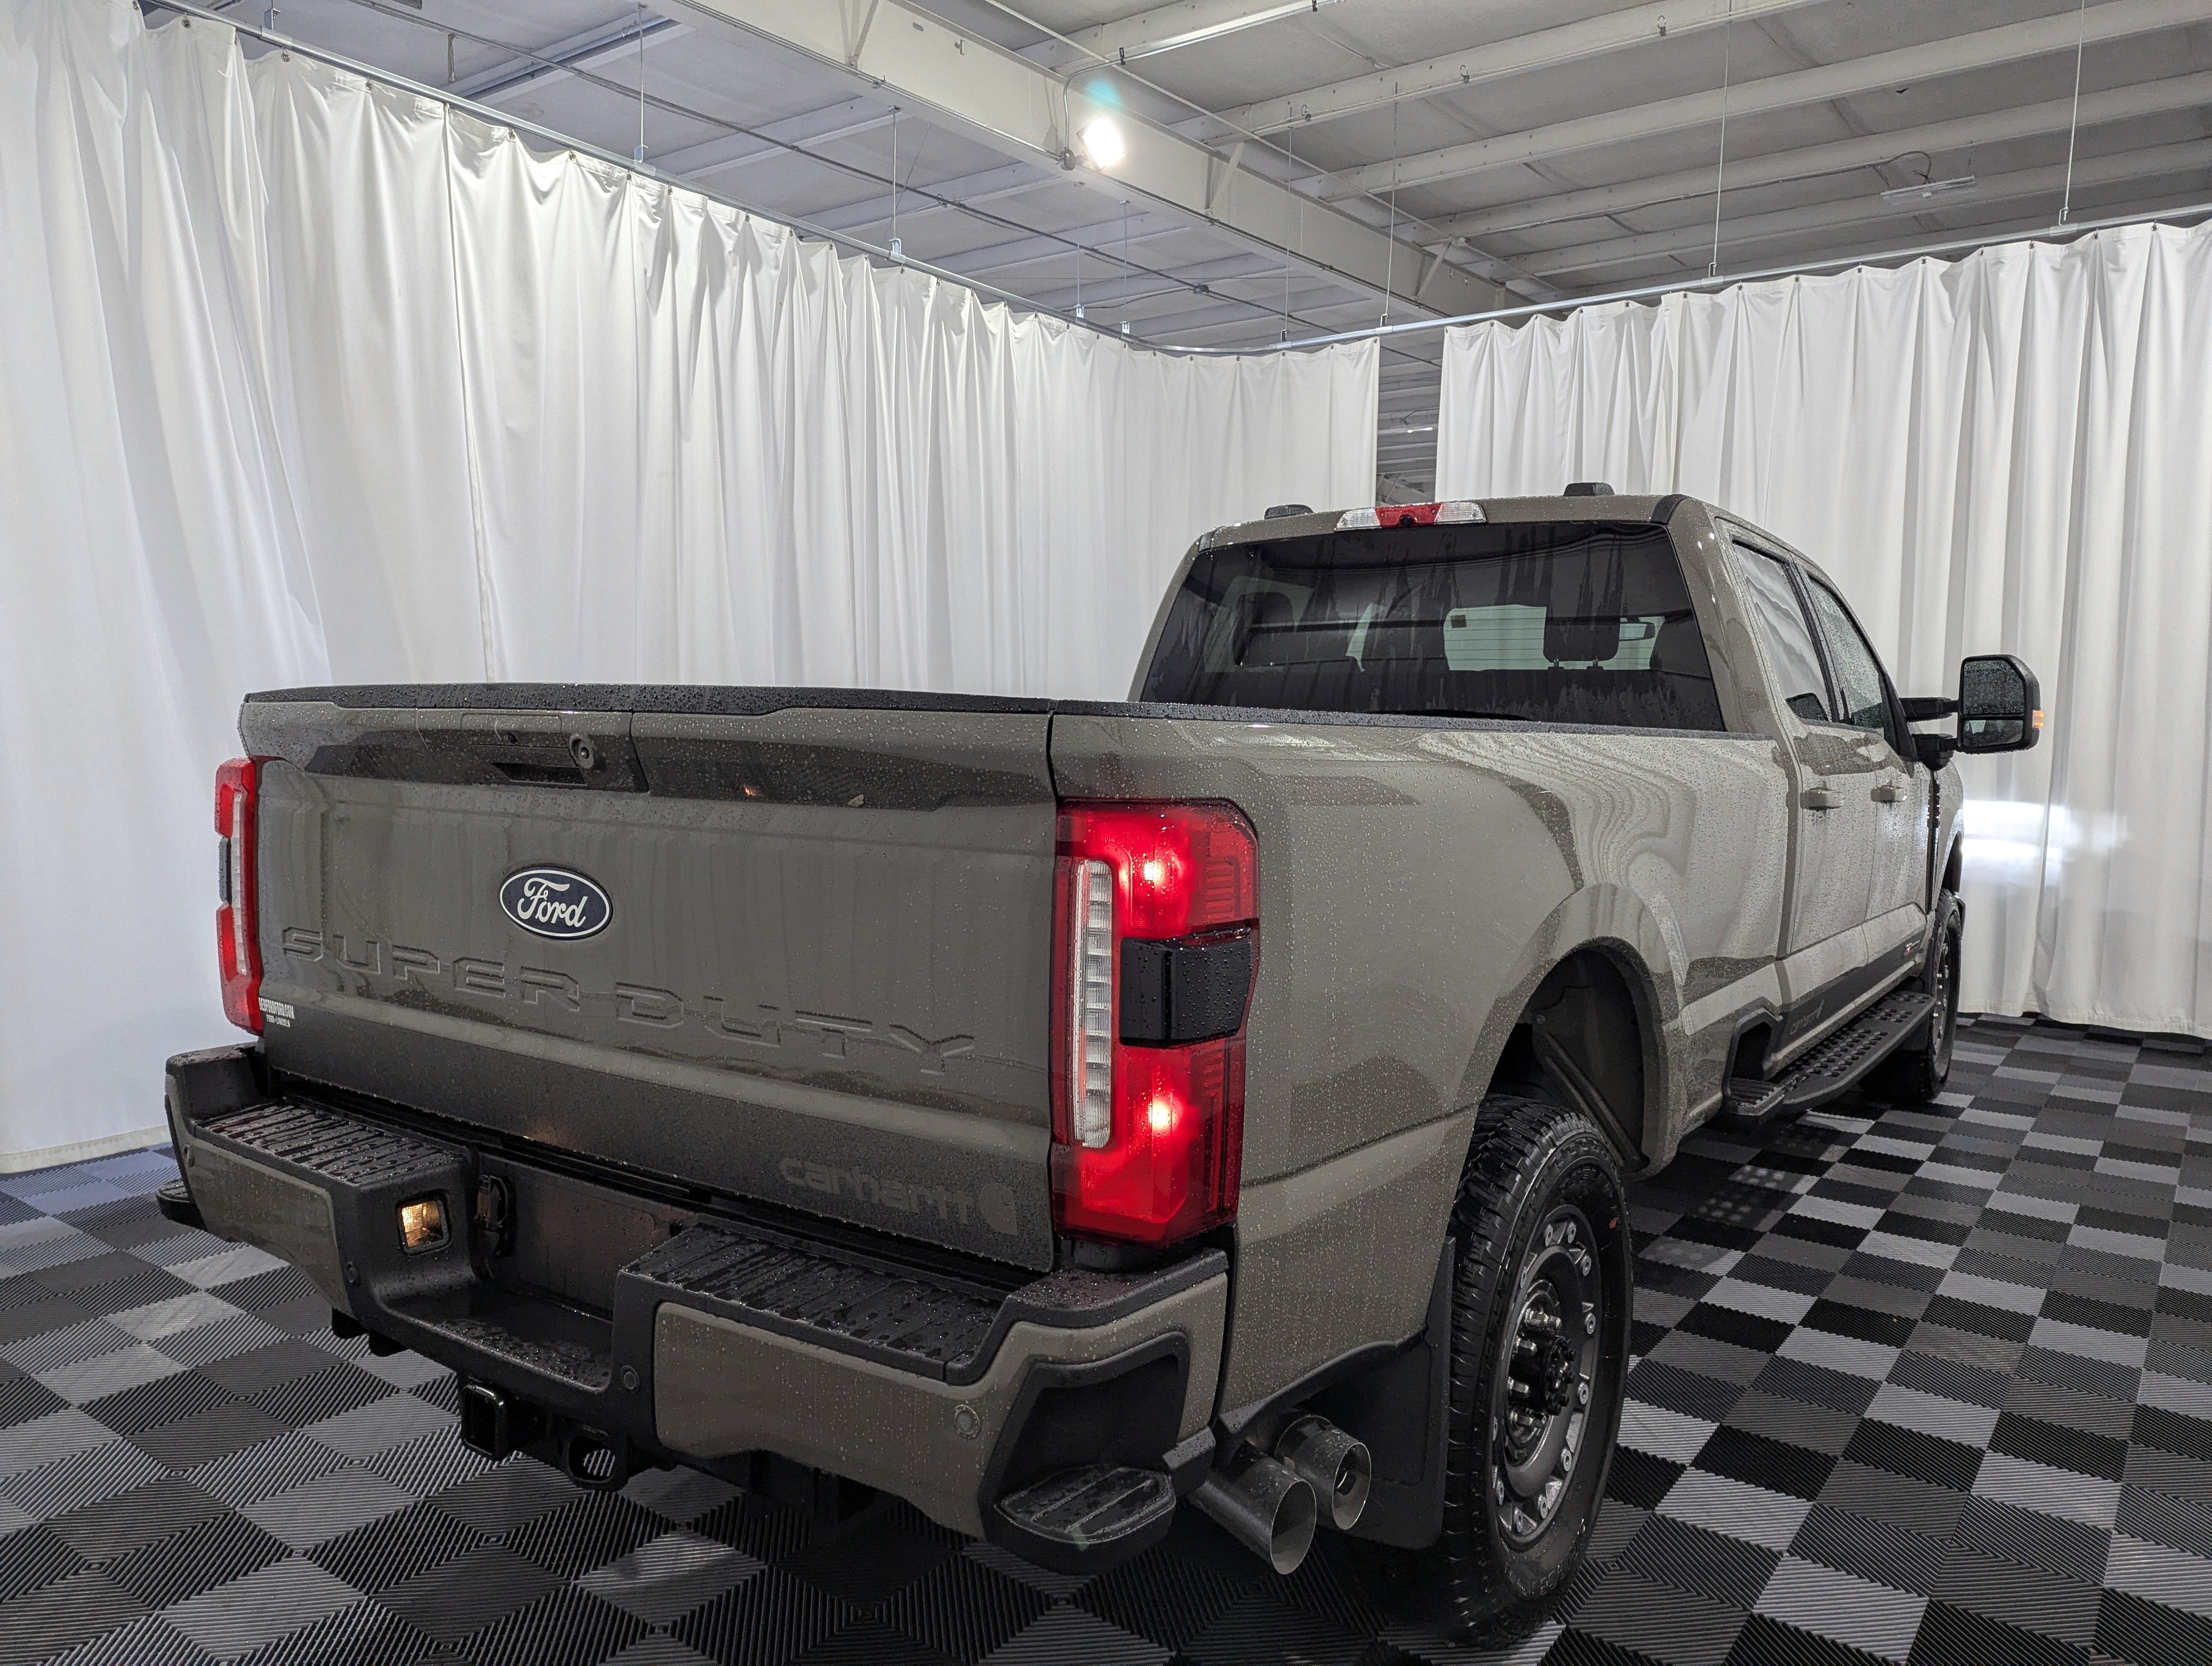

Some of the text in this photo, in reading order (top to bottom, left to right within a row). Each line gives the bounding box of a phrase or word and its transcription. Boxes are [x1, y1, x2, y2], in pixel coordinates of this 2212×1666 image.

[517, 877, 588, 927] Ford
[282, 926, 975, 1075] SUPER DUTY
